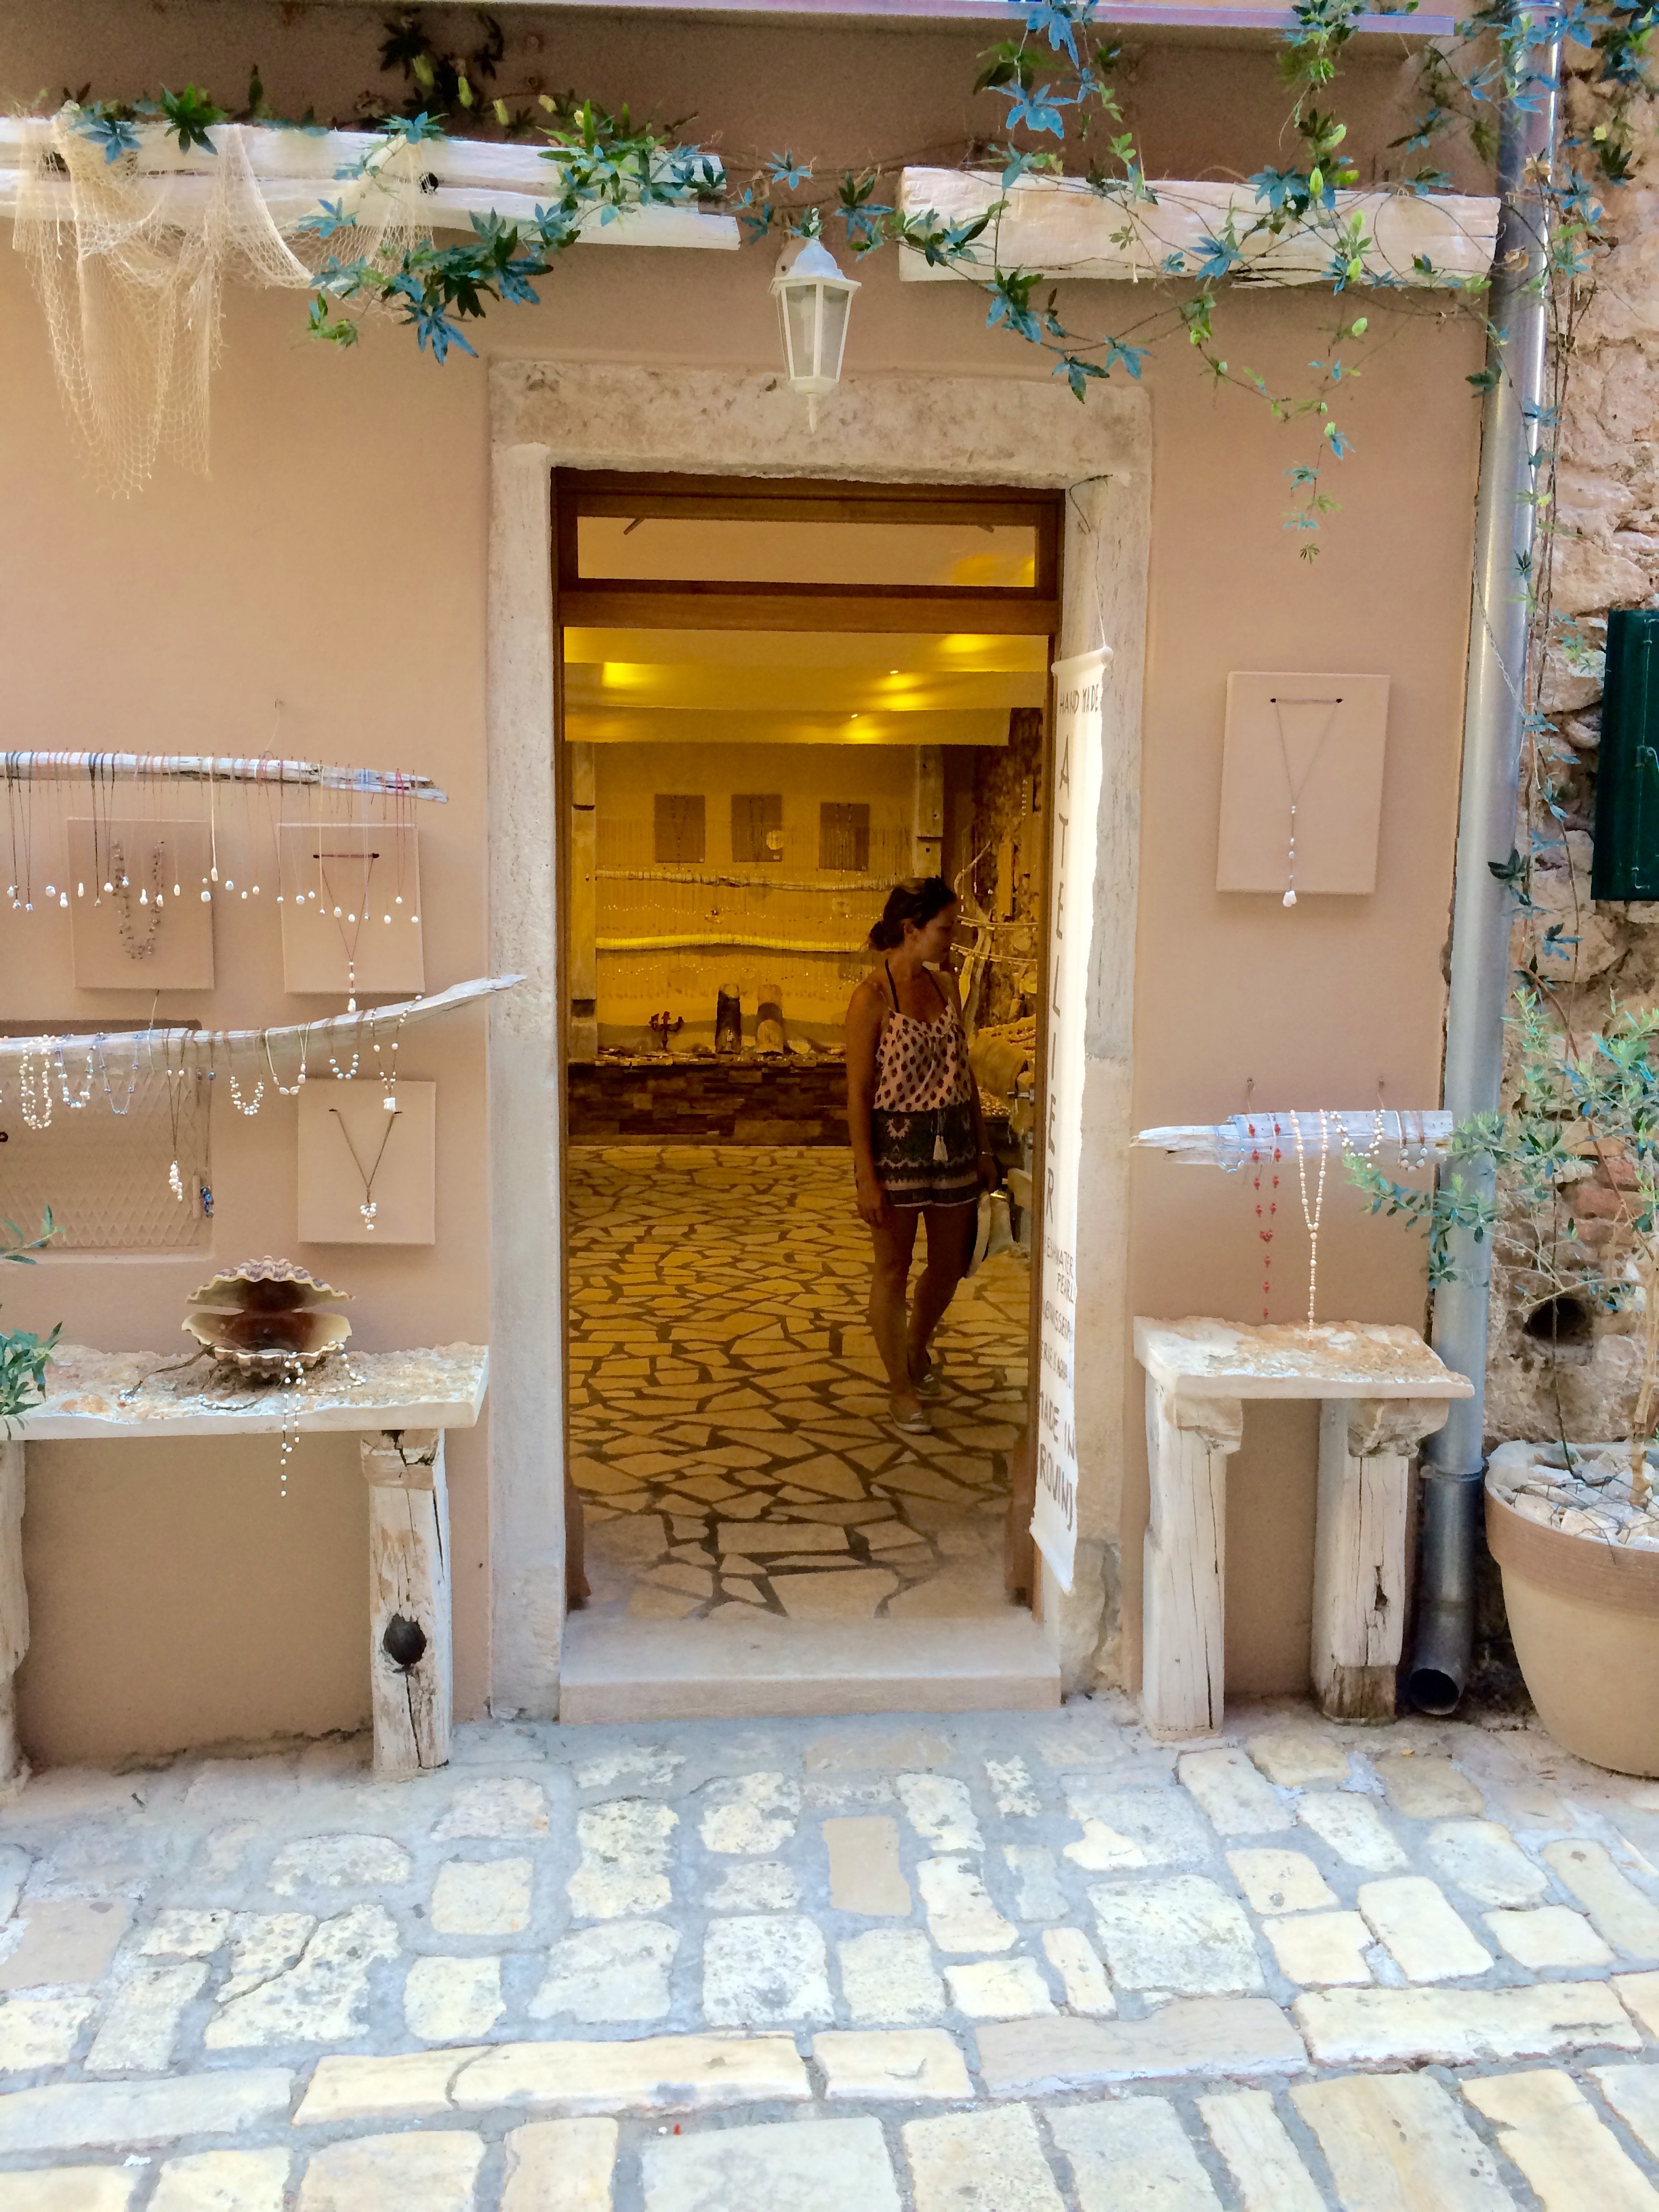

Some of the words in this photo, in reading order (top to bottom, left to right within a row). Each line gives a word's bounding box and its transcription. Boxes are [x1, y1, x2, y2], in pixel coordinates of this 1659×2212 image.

[1059, 690, 1080, 714] HAND
[1082, 684, 1099, 712] MADE
[1046, 735, 1069, 1224] ATELIER
[1064, 1419, 1075, 1460] IN
[1040, 1443, 1073, 1532] ROVINJ
